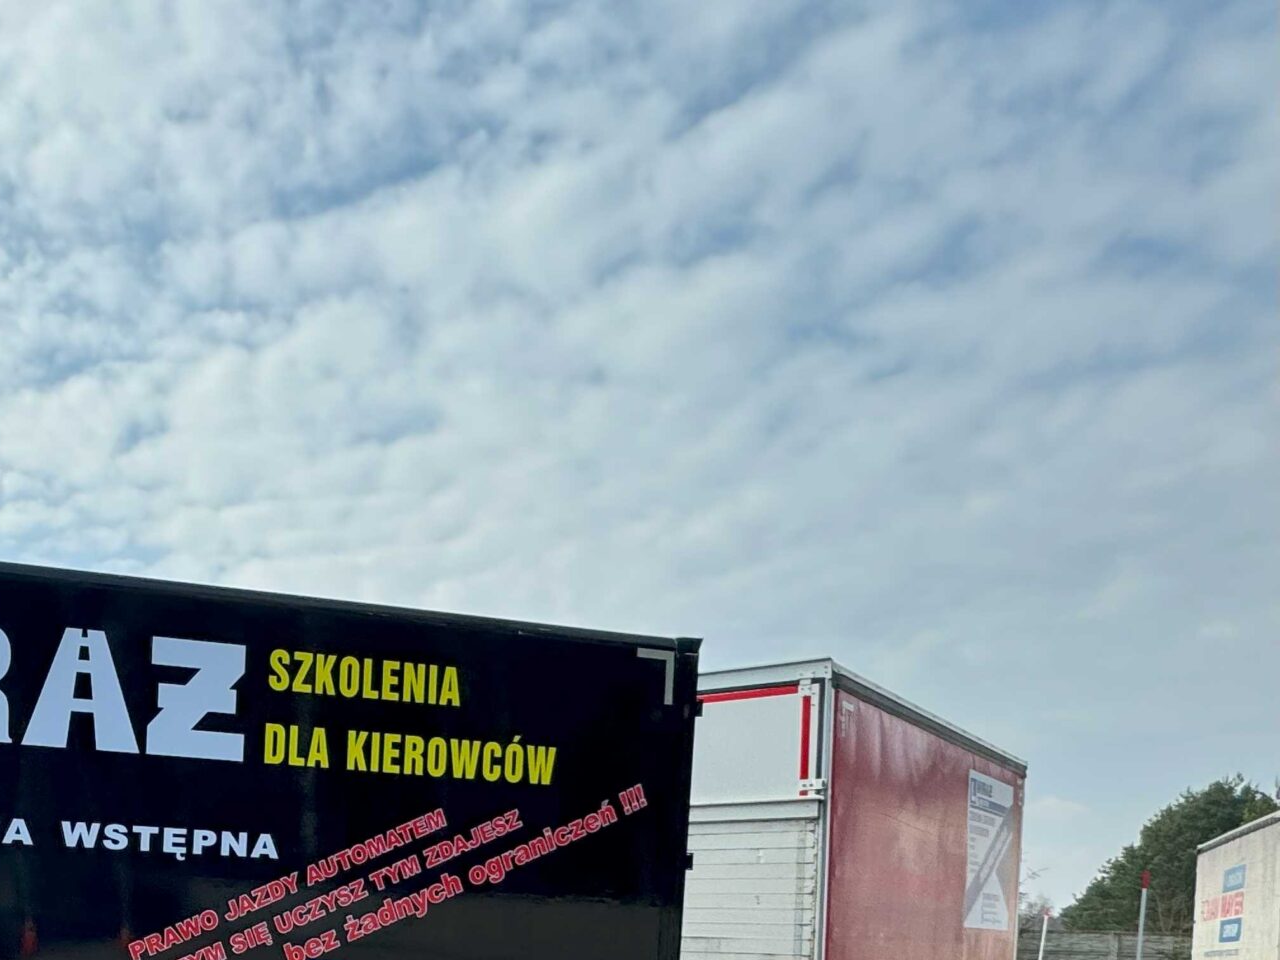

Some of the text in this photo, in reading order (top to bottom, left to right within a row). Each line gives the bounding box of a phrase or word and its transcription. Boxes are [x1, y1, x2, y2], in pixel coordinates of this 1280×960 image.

[269, 648, 461, 706] SZKOLENIA
[264, 722, 557, 785] DLA KIEROWCÓW
[61, 820, 279, 861] WSTĘPNA
[224, 871, 300, 921] JAZDY
[307, 807, 448, 886] AUTOMATEM
[229, 921, 273, 954] SIĘ
[273, 878, 369, 934] UCZYSZ
[369, 854, 422, 891] TYM
[422, 808, 523, 869] ZDAJESZ
[344, 872, 464, 943] żadnych
[468, 799, 619, 886] ograniczeń
